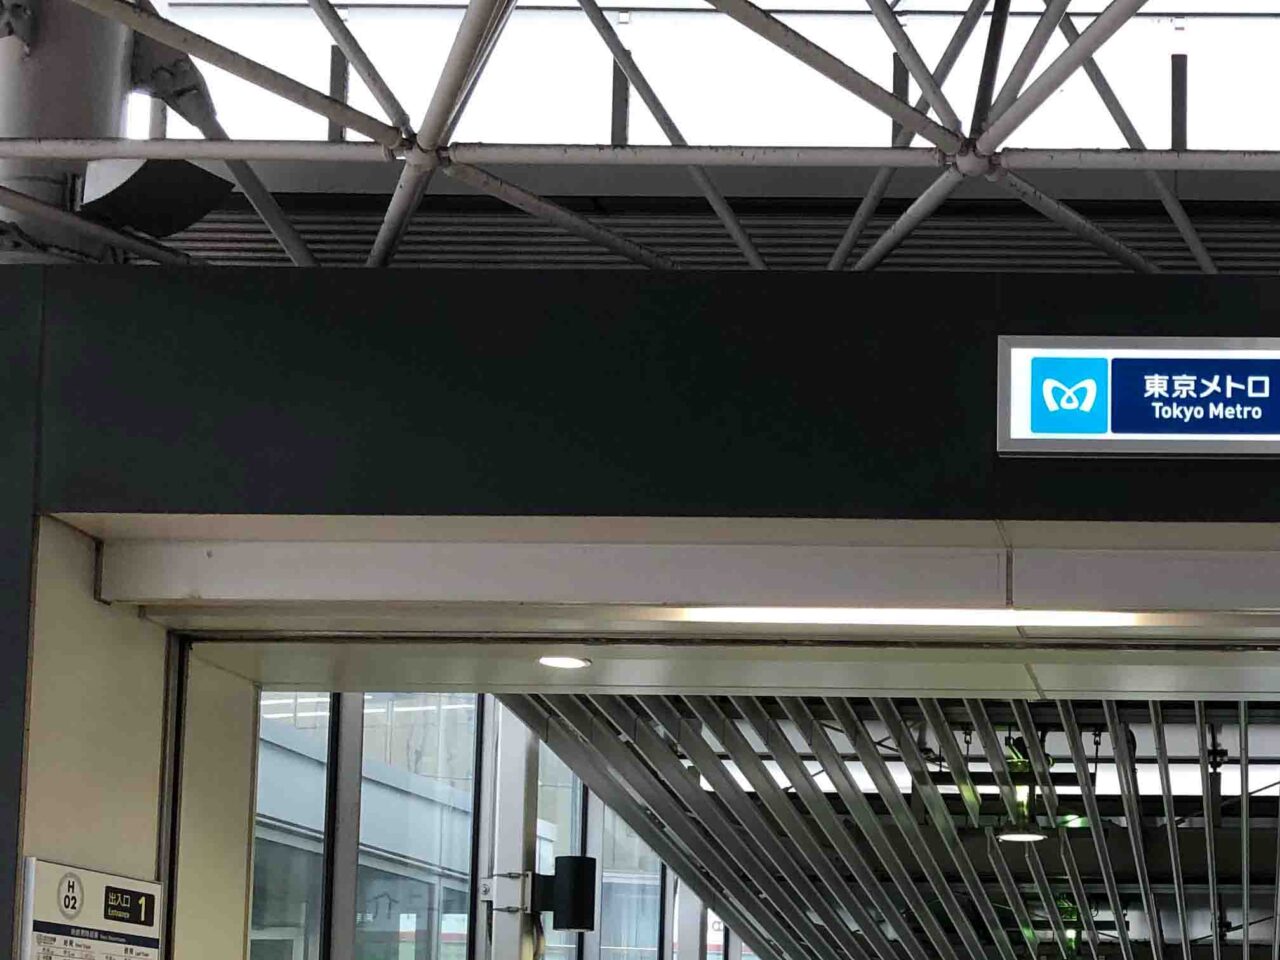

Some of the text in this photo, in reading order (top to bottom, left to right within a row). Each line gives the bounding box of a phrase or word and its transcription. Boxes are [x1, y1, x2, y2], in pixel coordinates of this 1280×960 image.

[1143, 373, 1270, 399] 東京メトロ
[1151, 402, 1263, 423] Tokyo Metro
[67, 880, 75, 894] H
[63, 894, 77, 911] 02
[108, 892, 146, 922] 出入口 1
